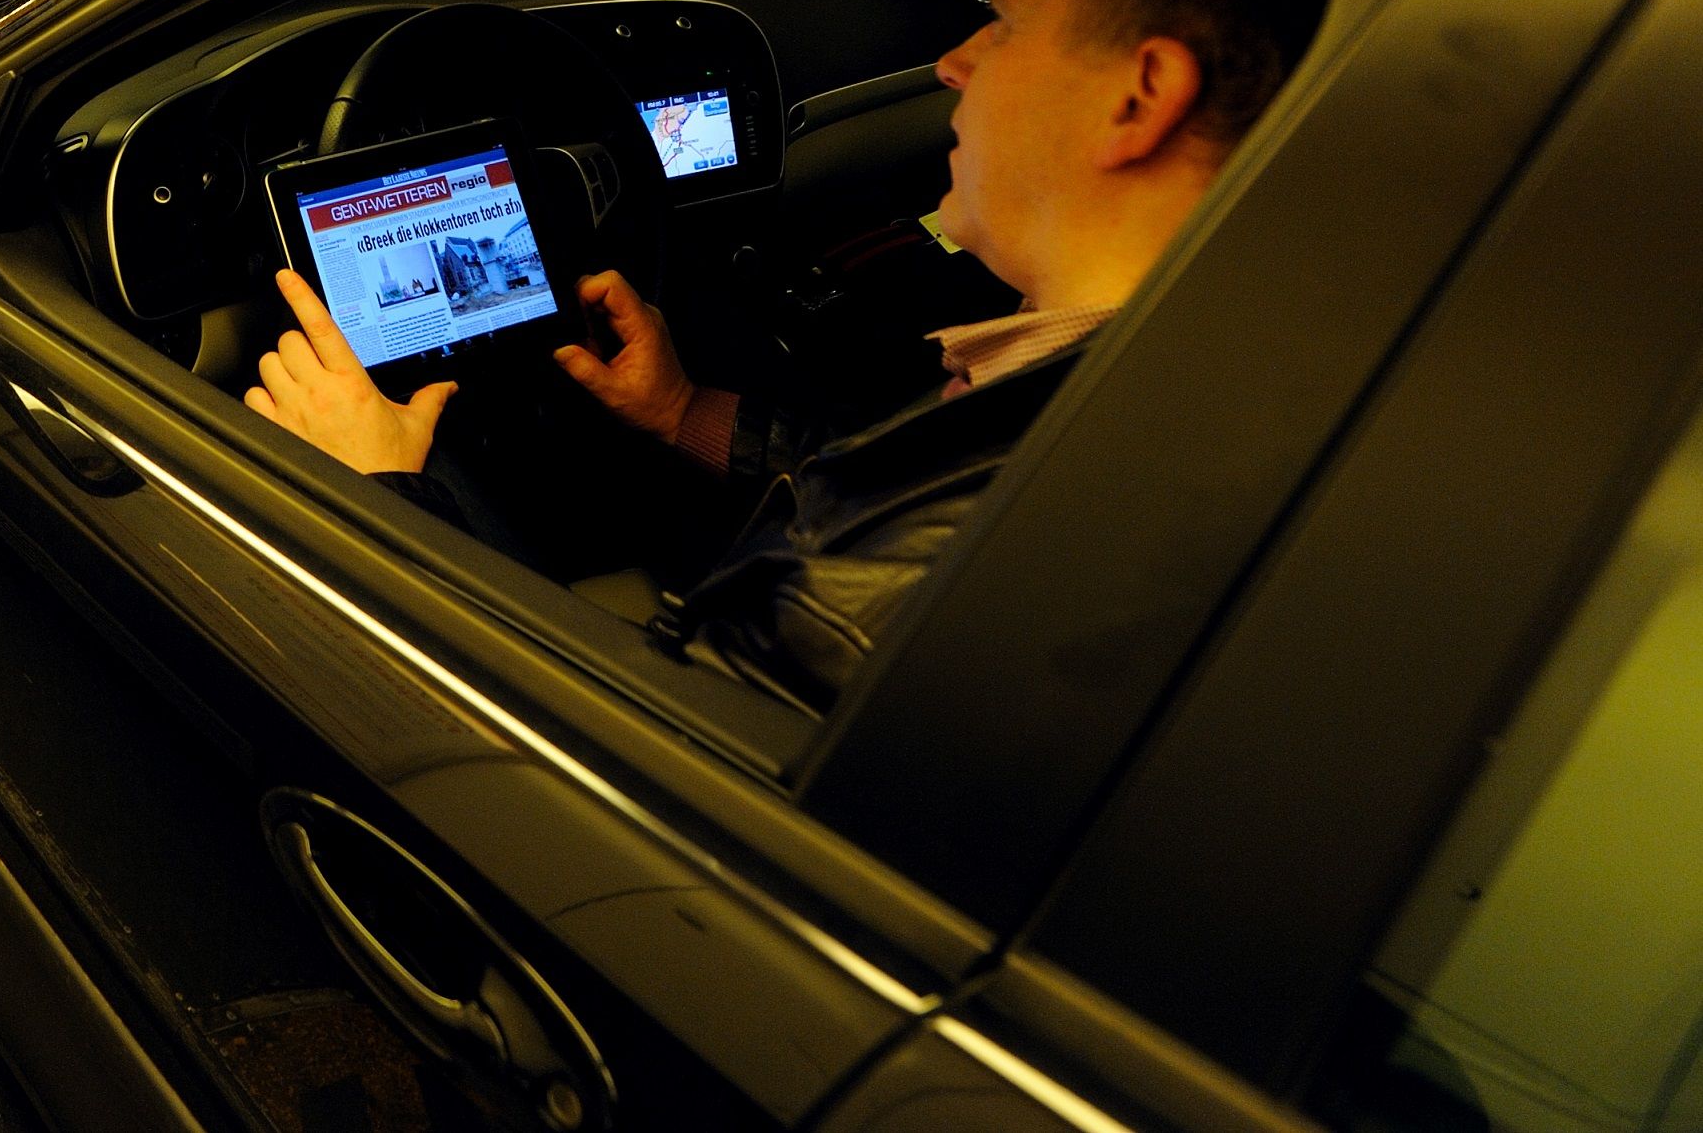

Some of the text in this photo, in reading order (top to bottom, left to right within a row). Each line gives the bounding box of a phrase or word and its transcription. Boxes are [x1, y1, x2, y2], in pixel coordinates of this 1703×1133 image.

[329, 180, 448, 223] GENT-WETTEREN
[450, 173, 487, 192] regio
[356, 197, 523, 253] «Breek die klokkentoren toch af»
